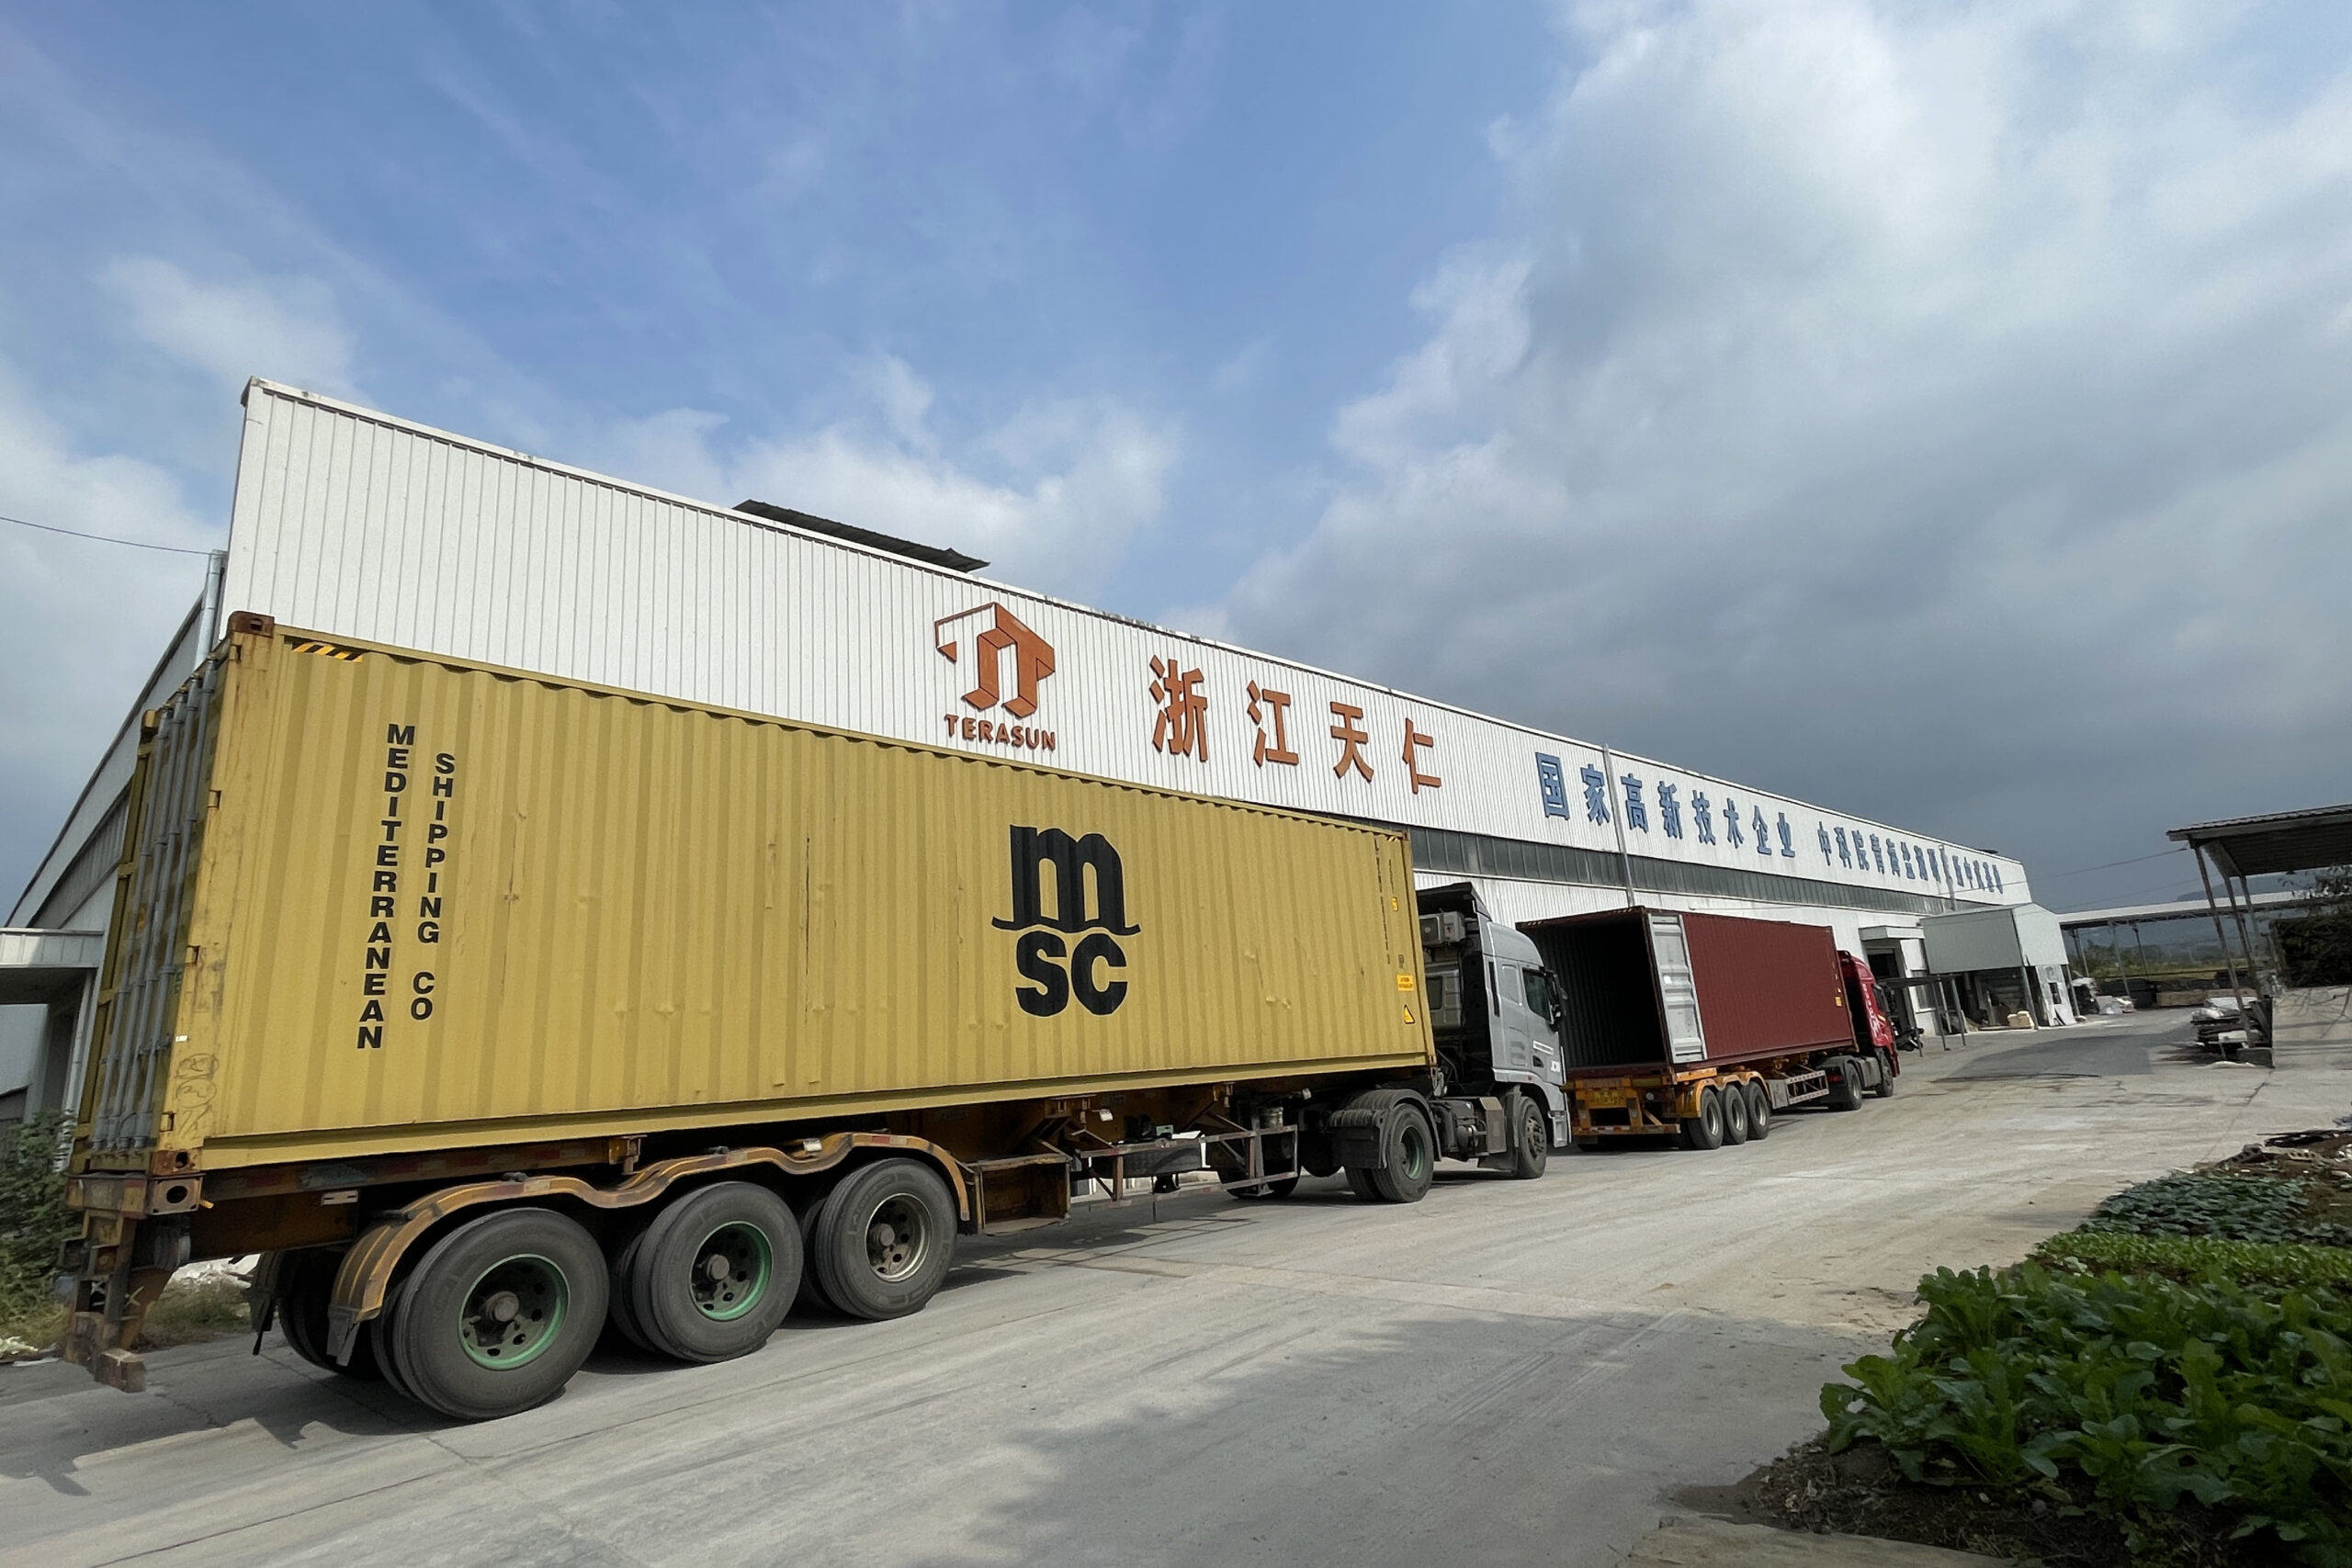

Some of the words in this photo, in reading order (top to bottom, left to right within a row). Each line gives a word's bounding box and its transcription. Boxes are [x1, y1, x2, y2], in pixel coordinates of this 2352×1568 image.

[945, 713, 1056, 750] TERASUN
[1150, 654, 1442, 793] 浙江天仁
[417, 752, 456, 943] SHIPPING
[1535, 752, 1795, 857] 国家高新技术企业
[357, 723, 415, 1049] MEDITERRANEAN
[411, 971, 435, 1021] CO
